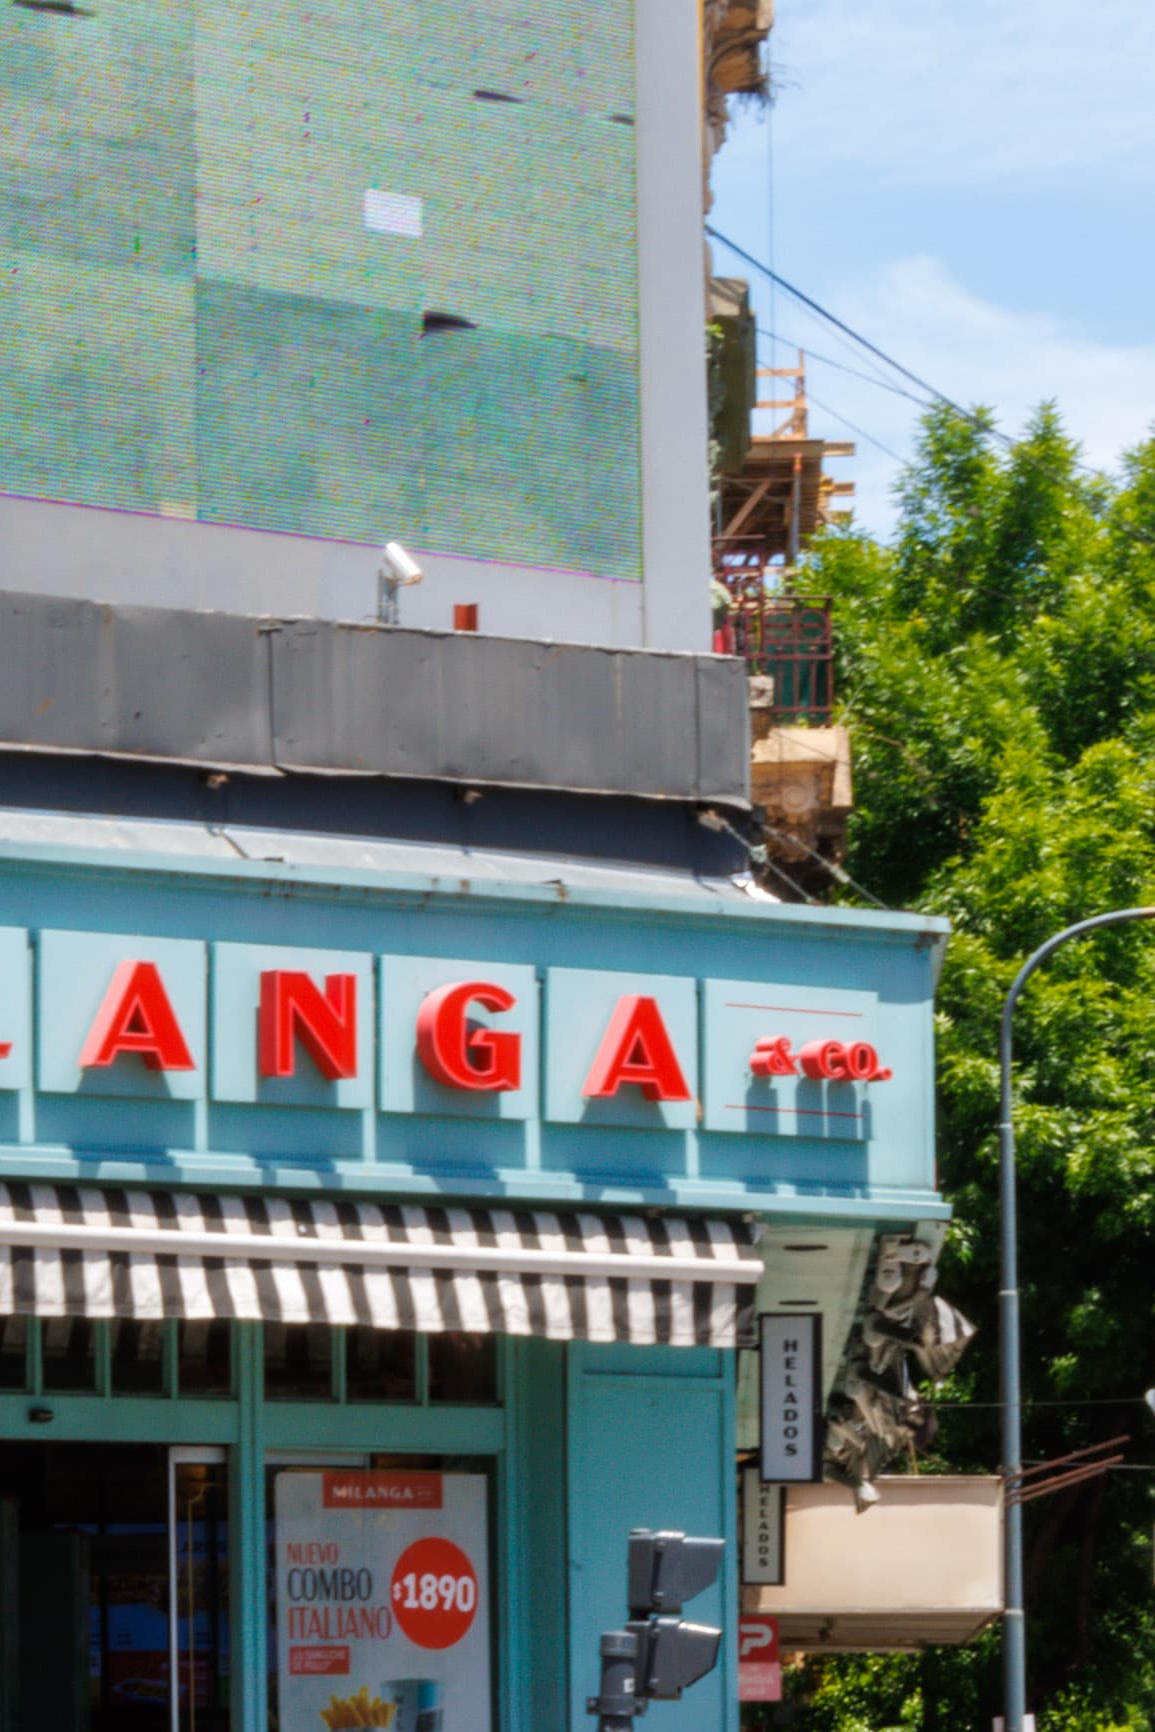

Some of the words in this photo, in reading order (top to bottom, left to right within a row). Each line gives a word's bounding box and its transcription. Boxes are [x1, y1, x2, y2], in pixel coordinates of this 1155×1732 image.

[782, 1338, 799, 1457] HELADOS
[332, 1485, 414, 1500] MILANGA
[286, 1542, 339, 1565] NUEVO
[287, 1567, 372, 1601] COMBO
[392, 1572, 476, 1612] $1890
[288, 1605, 392, 1641] ITALIANO
